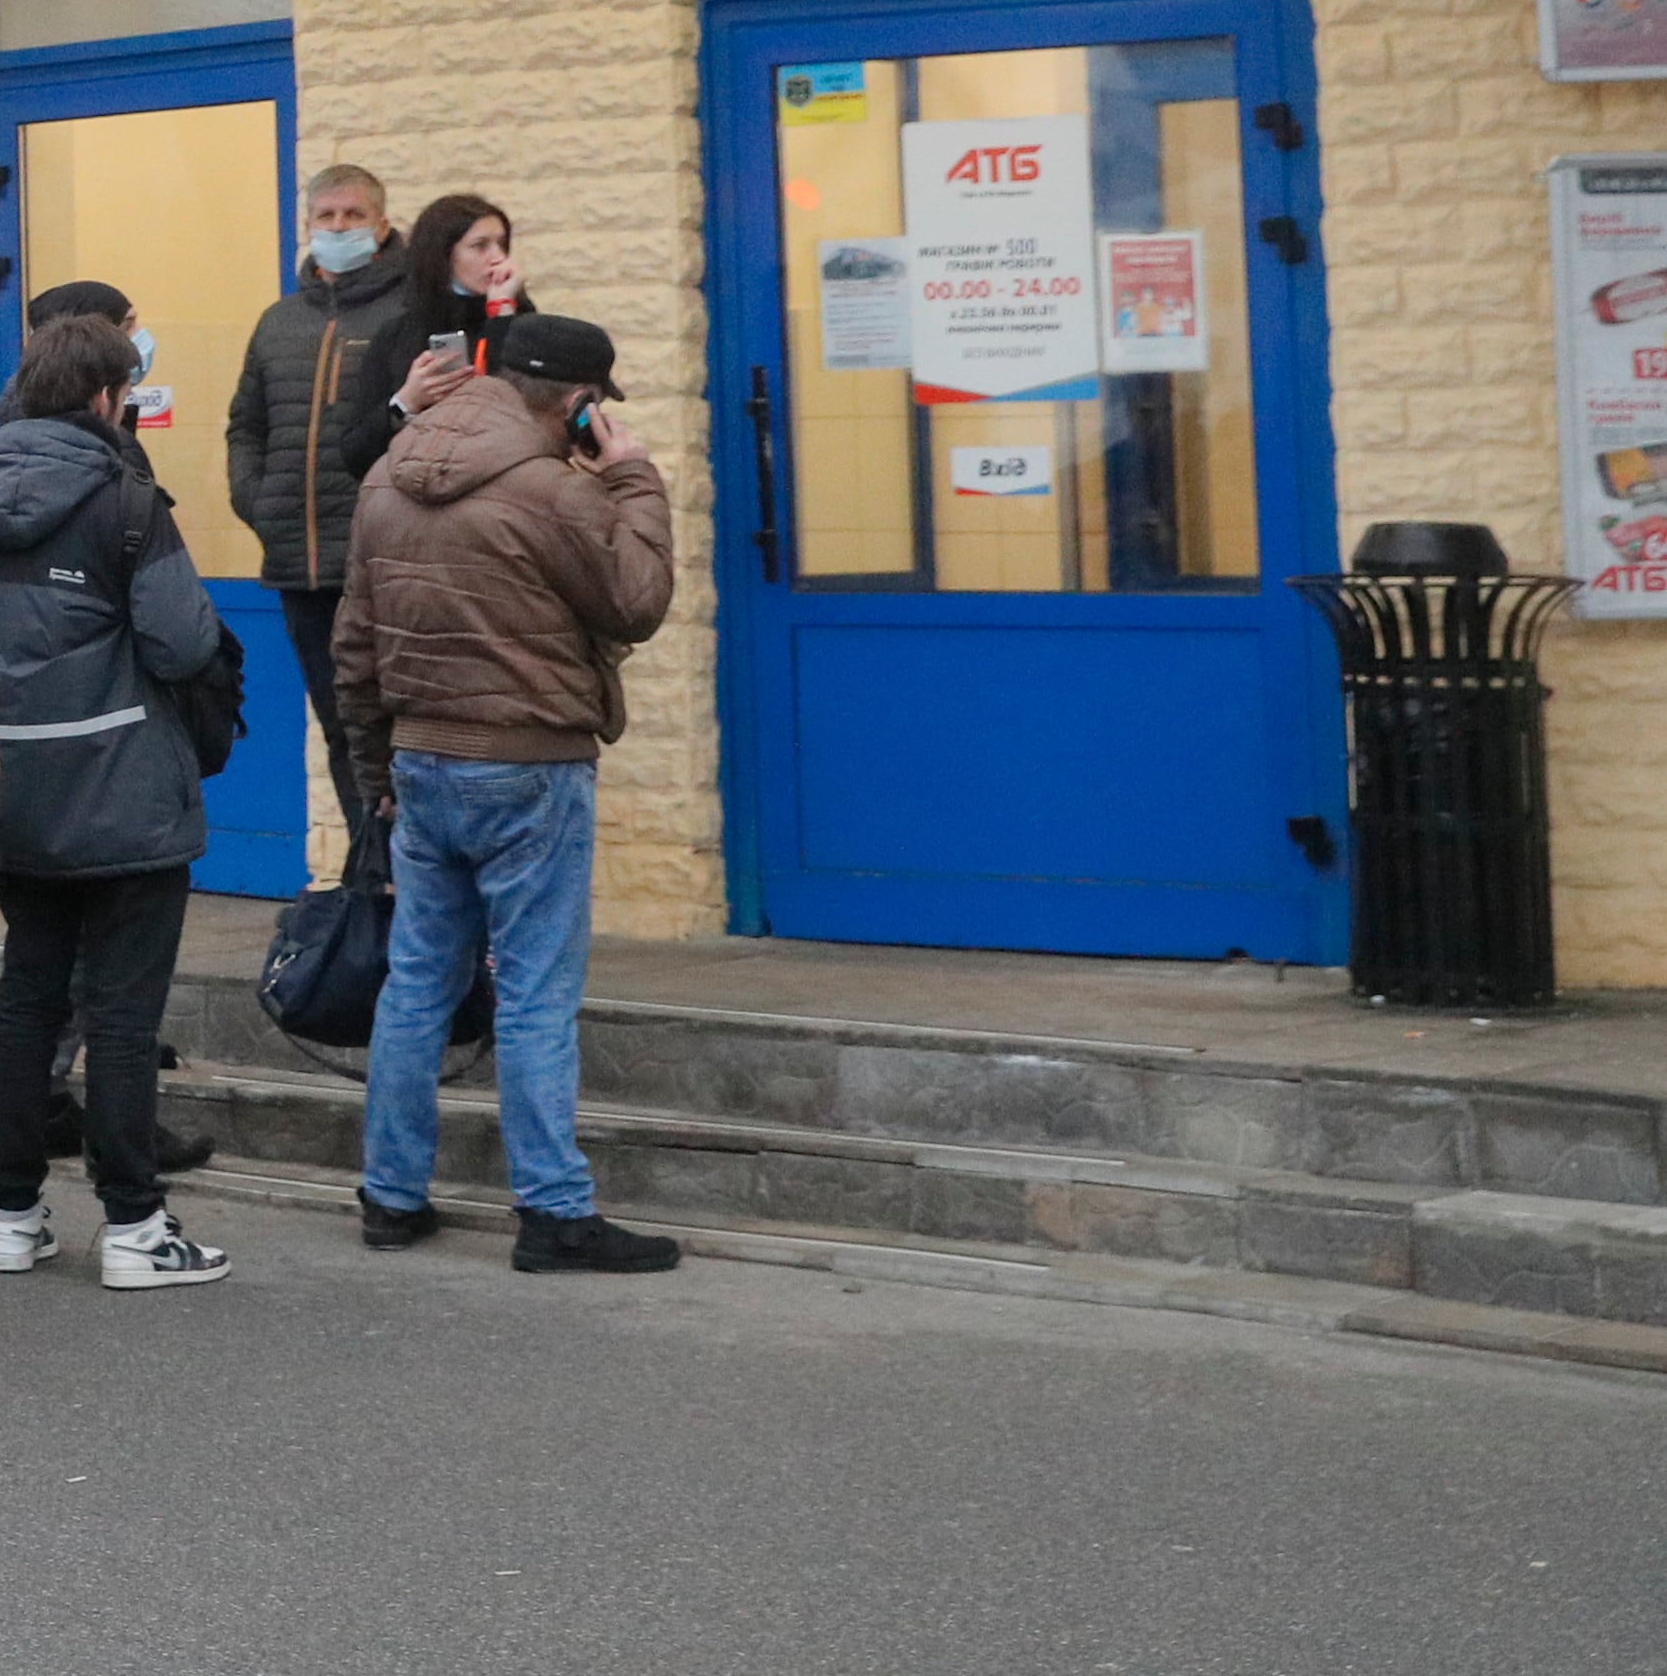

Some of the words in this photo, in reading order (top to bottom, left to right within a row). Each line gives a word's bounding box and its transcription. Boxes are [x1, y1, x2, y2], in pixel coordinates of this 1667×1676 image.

[945, 144, 1043, 184] АТБ
[923, 278, 991, 301] 00.00
[1013, 275, 1082, 298] 24.00
[1592, 566, 1667, 592] АТБ
